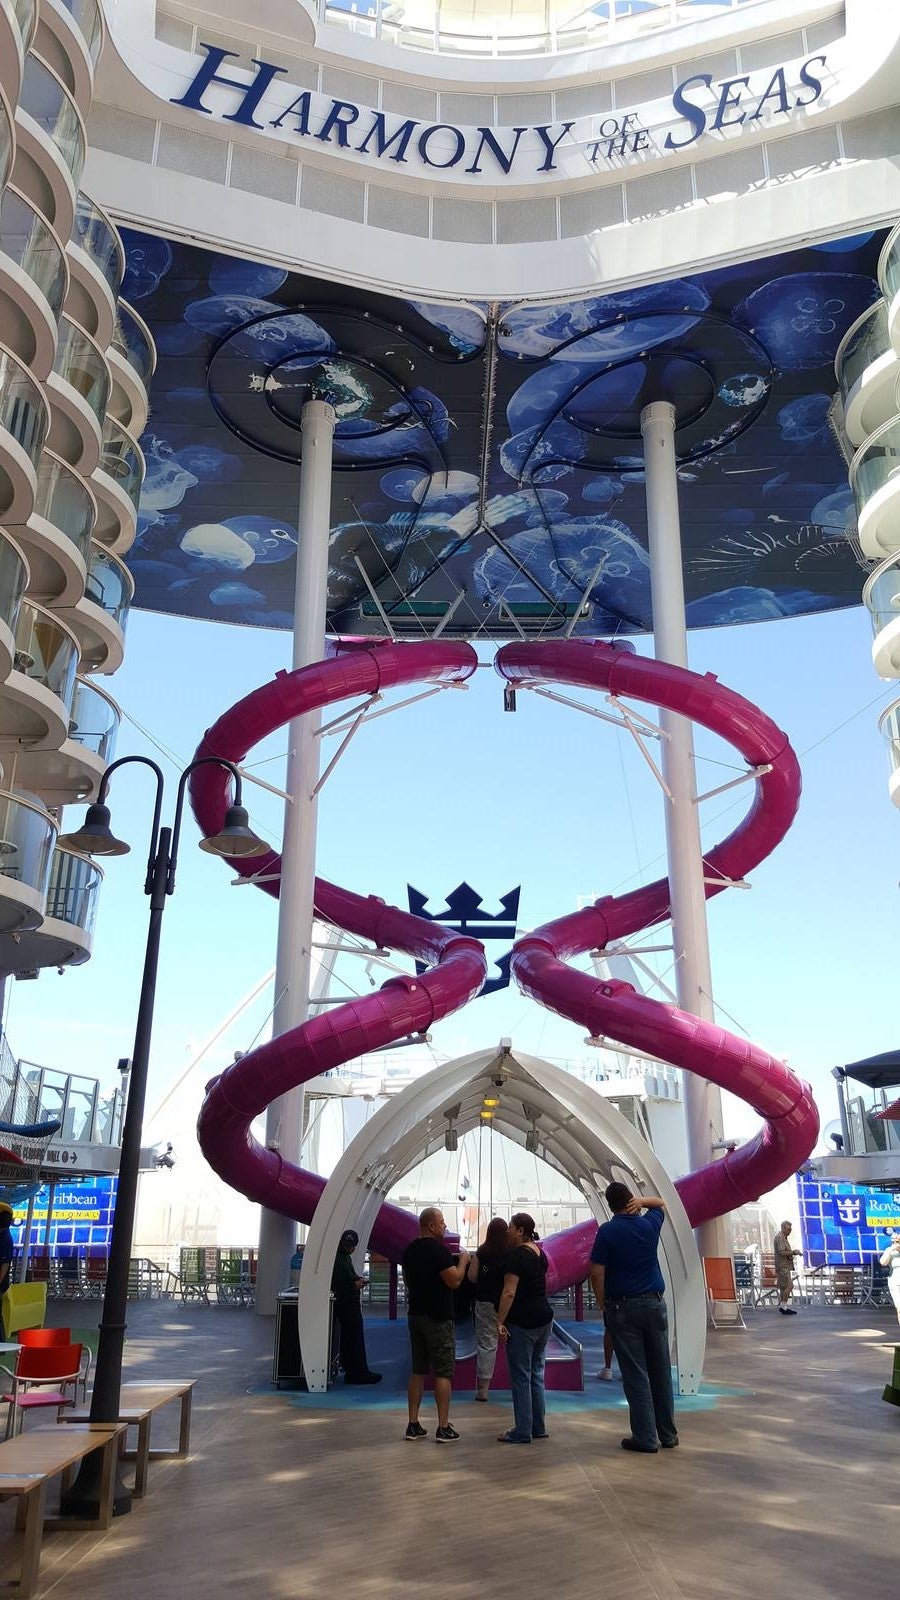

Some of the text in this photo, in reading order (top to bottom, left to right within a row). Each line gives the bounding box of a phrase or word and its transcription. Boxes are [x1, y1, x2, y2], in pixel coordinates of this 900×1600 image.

[169, 42, 827, 174] HARMONY OF THE SEAS
[36, 1192, 97, 1205] Cribbean
